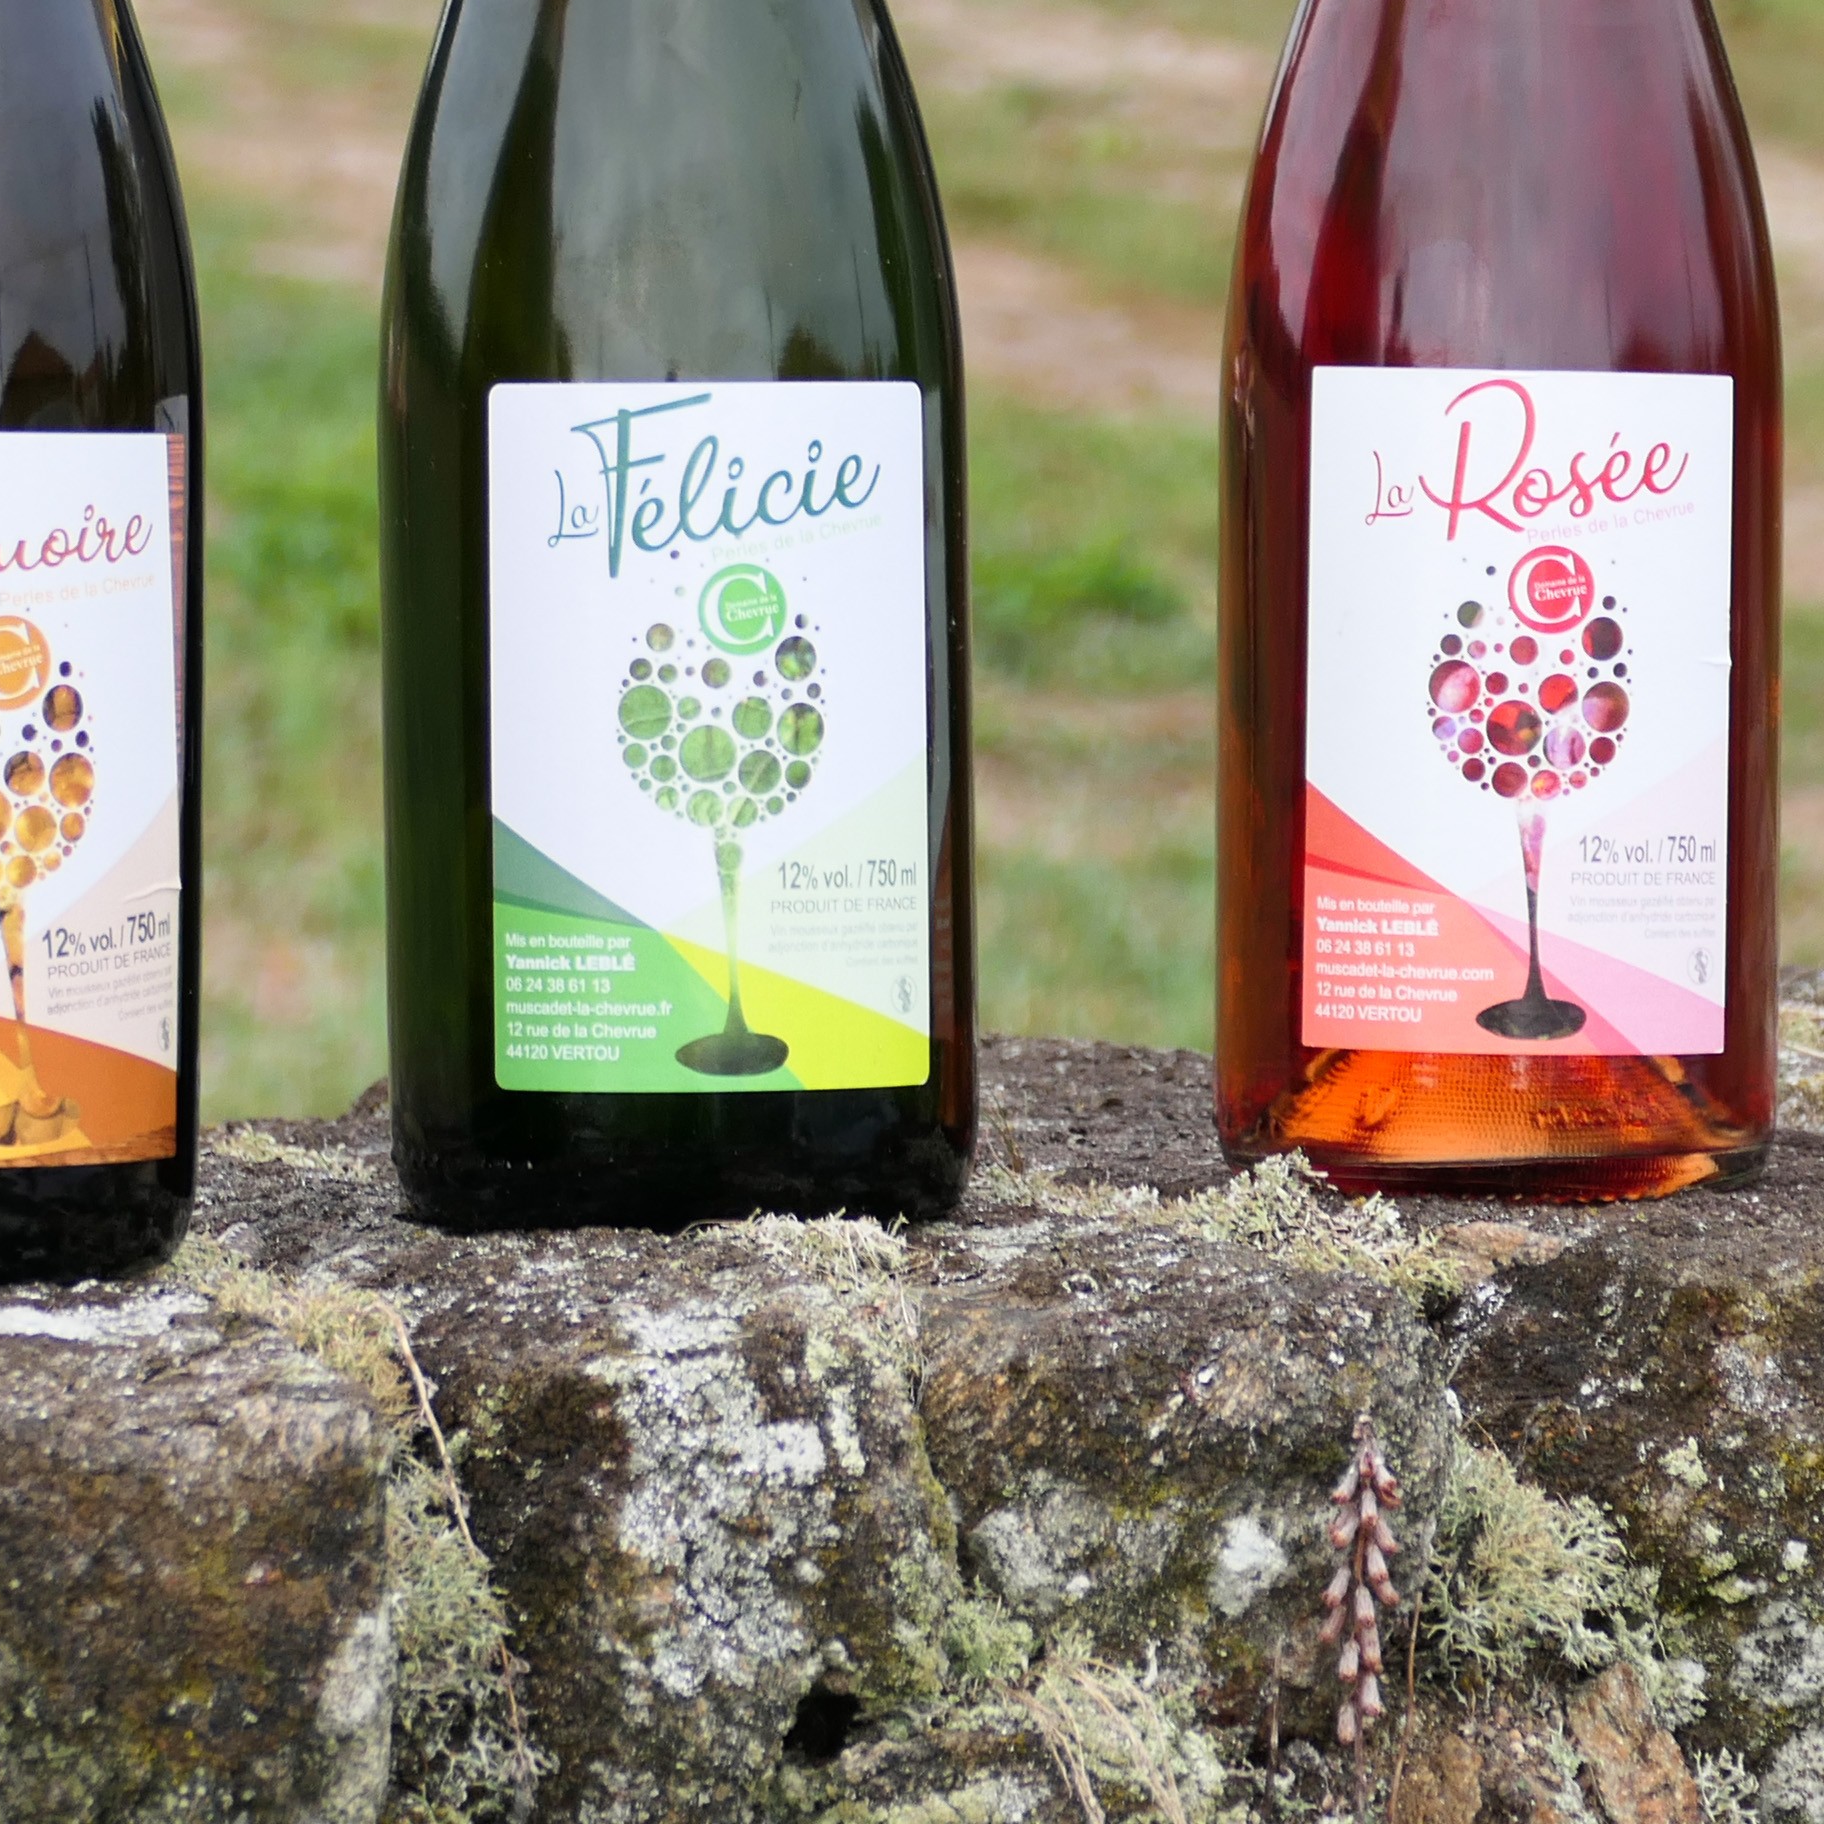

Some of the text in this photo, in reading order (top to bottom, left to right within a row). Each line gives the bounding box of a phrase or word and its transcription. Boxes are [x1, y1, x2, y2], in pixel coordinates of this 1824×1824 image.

[1365, 379, 1689, 541] La Rosée
[547, 393, 880, 579] La Félicie
[1527, 502, 1695, 544] Perles de la Chevrue
[711, 514, 882, 562] Perles de la Chevrue
[60, 585, 79, 601] de
[85, 582, 97, 597] la
[102, 574, 154, 594] Chevrue
[1534, 583, 1587, 601] Chevrue
[726, 602, 779, 622] Chevrue
[1579, 835, 1619, 864] 12%
[1624, 839, 1653, 863] vol.
[1667, 835, 1697, 863] 750
[1700, 839, 1716, 863] ml
[778, 861, 818, 890] 12%
[823, 864, 853, 888] vol.
[867, 859, 897, 887] 750
[901, 861, 917, 887] ml
[1570, 871, 1716, 886] PRODUIT DE FRANCE
[770, 896, 917, 915] PRODUIT DE FRANCE
[1316, 896, 1435, 917] Mis en bouteille par
[42, 928, 86, 959] 12%
[89, 926, 117, 952] vol.
[127, 911, 156, 945] 750
[158, 913, 170, 937] ml
[1316, 916, 1439, 936] Yannick LEBLÉ
[505, 933, 631, 952] Mis en bouteille par
[1316, 938, 1415, 957] 06 24 38 61 13
[47, 957, 109, 979] PRODUIT
[114, 953, 130, 969] DE
[133, 942, 171, 964] FRANCE
[505, 952, 636, 971] Yannick LEBLÉ
[1316, 961, 1494, 981] muscadet-la-chevrue.com
[506, 977, 611, 994] 06 24 38 61 13
[1316, 981, 1458, 1002] 12 rue de la Chevrue
[506, 1000, 673, 1016] muscadet-la-chevrue.fr
[1315, 1003, 1422, 1022] 44120 VERTOU
[508, 1021, 657, 1039] 12 rue de la Chevrue
[506, 1044, 620, 1061] 44120 VERTOU
